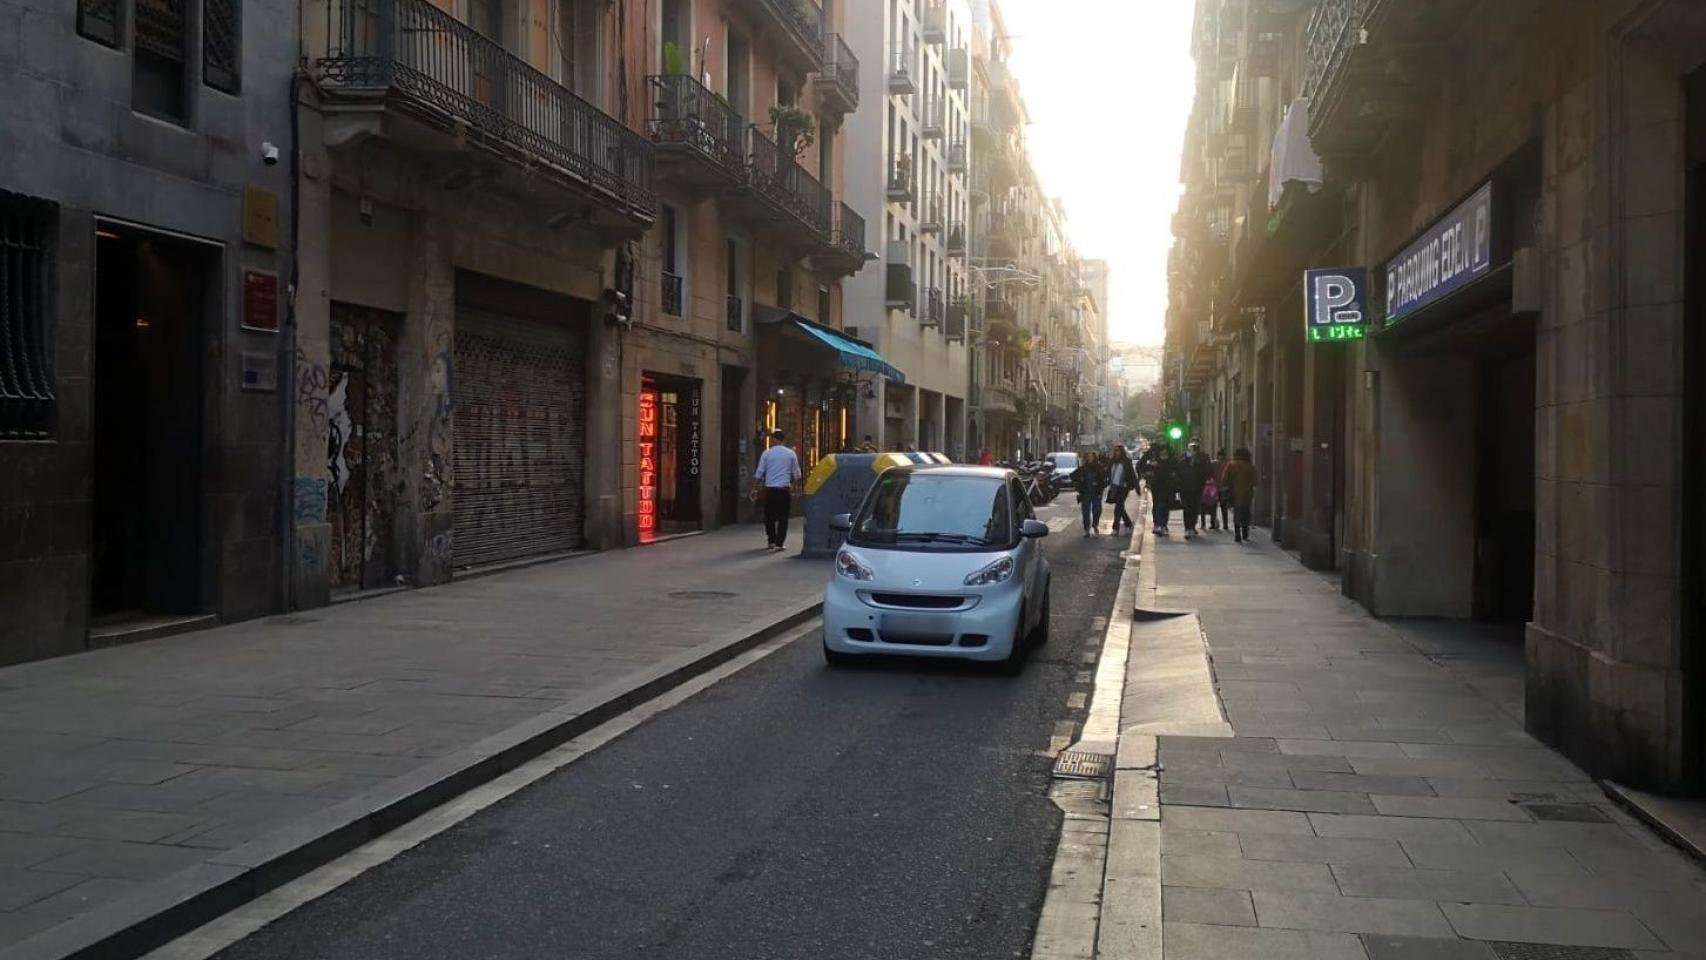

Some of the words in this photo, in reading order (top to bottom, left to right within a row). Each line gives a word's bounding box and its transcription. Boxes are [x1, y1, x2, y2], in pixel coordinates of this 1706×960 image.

[1387, 270, 1396, 315] P
[1442, 217, 1470, 282] EDEN
[1474, 205, 1487, 264] P
[1315, 275, 1355, 323] P
[639, 393, 654, 437] SUN
[691, 421, 699, 475] TATTOO
[639, 443, 654, 528] TATTOO
